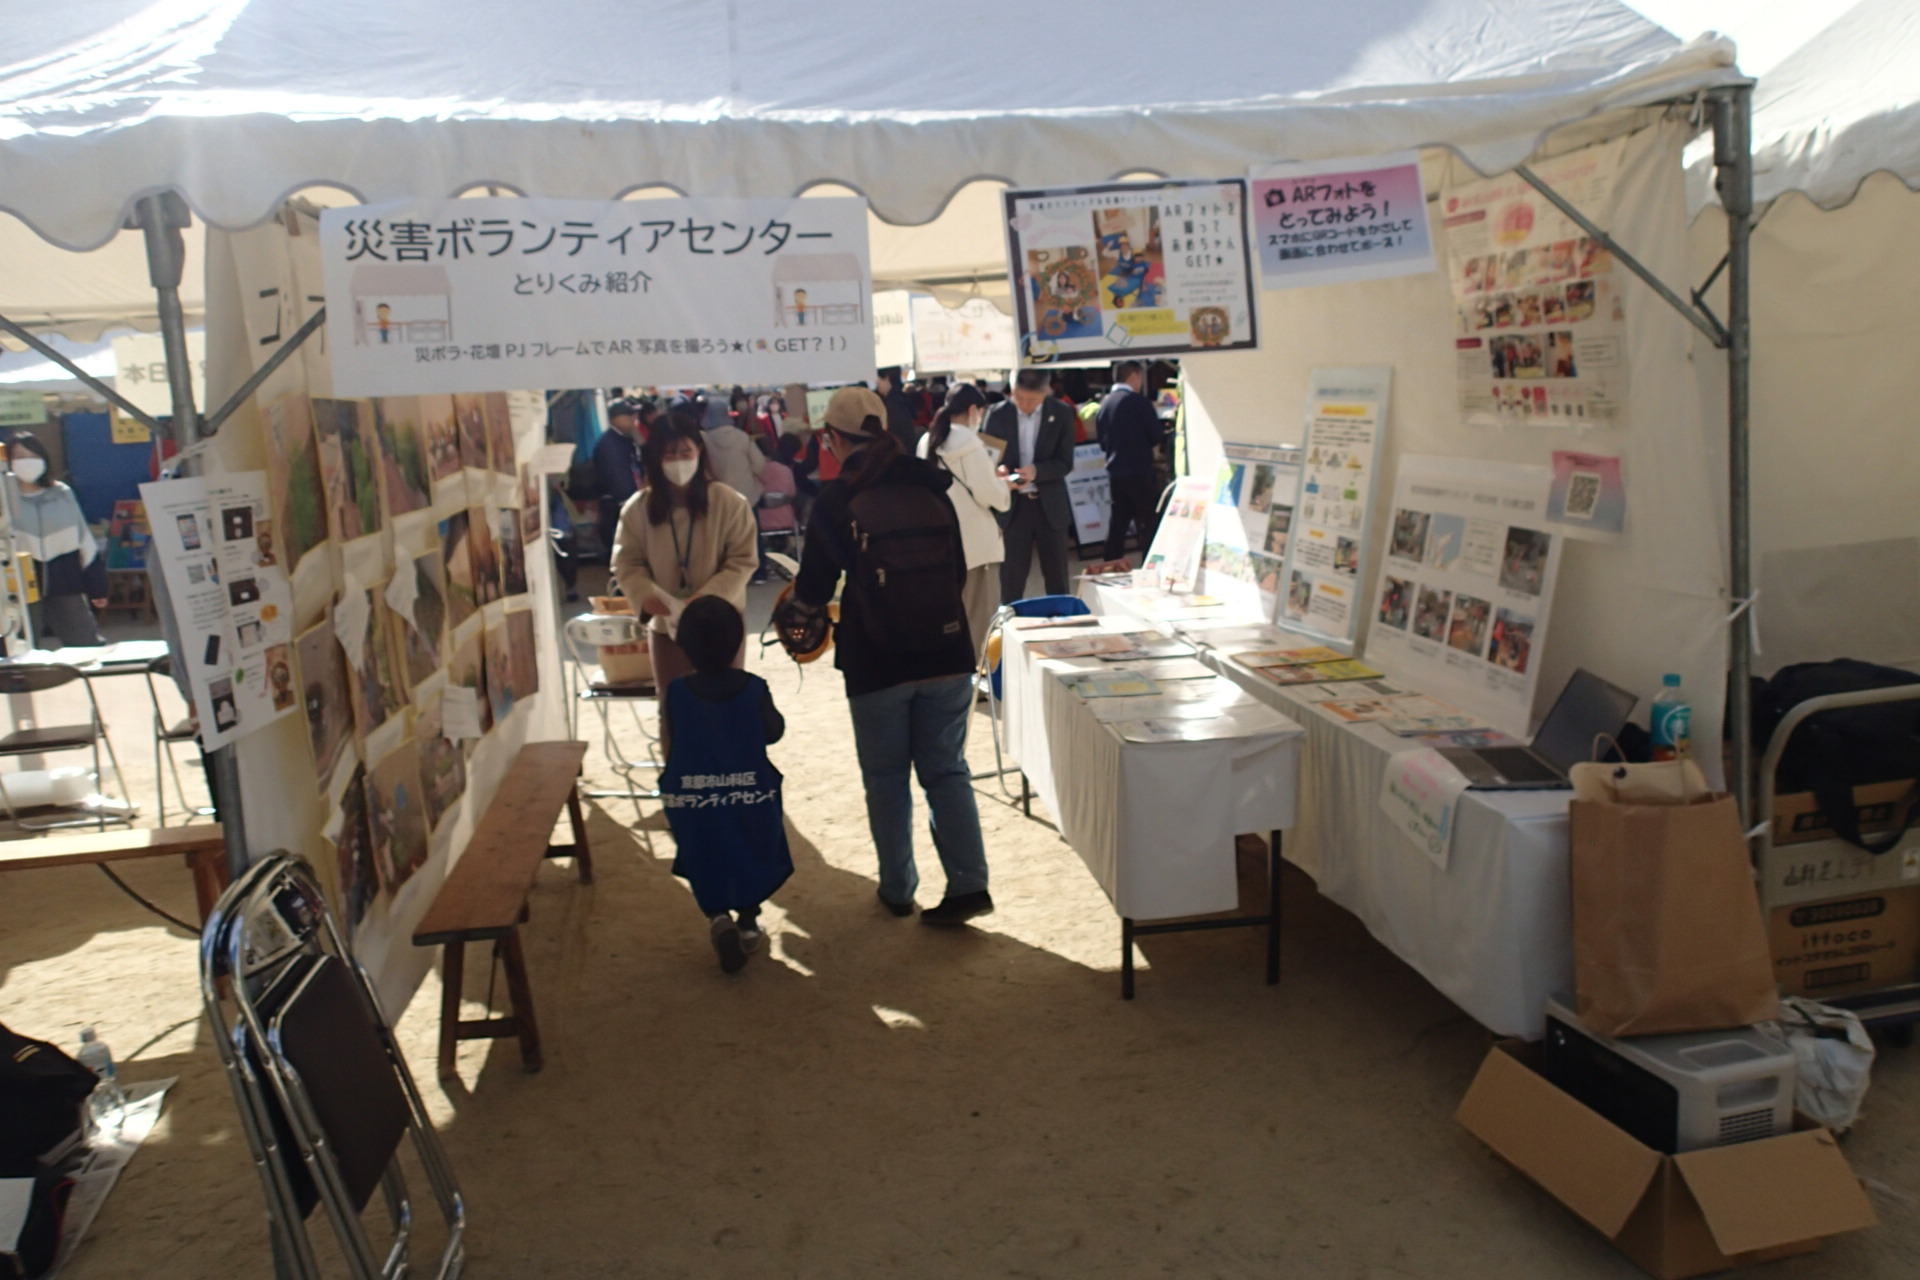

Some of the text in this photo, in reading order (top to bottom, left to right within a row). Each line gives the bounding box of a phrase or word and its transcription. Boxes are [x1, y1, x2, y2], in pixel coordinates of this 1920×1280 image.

[344, 217, 834, 262] 災害ボランティアセンター
[513, 270, 653, 295] とりくみ紹介
